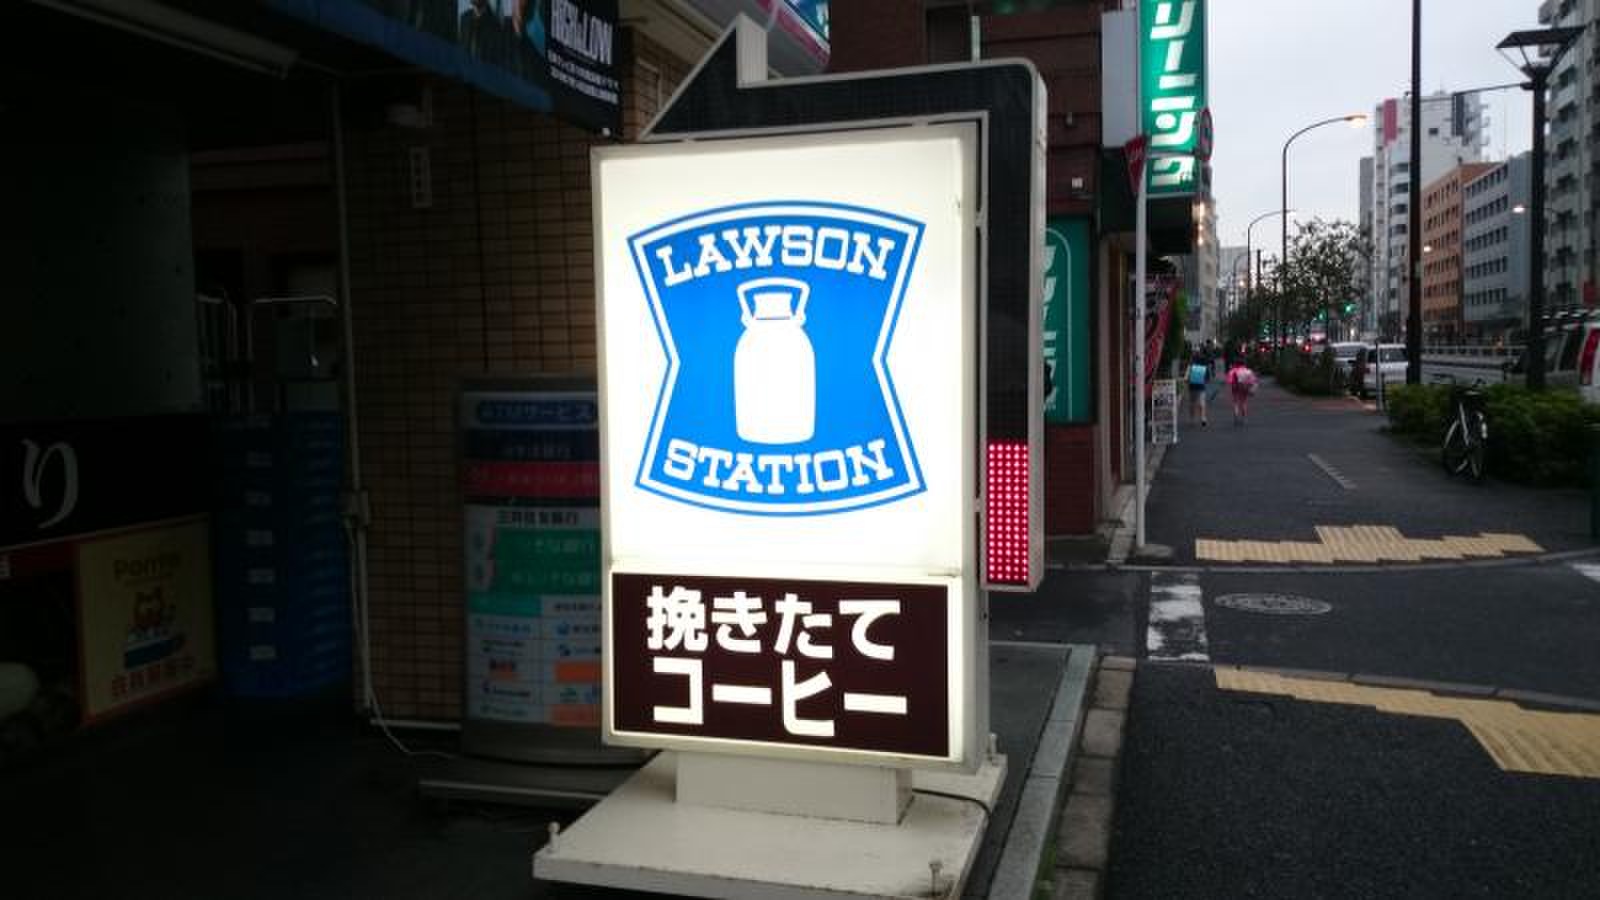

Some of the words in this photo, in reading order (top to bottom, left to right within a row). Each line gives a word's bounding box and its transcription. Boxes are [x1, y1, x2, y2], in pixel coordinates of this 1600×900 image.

[656, 225, 895, 287] LAWSON
[20, 437, 81, 529] り
[663, 438, 894, 494] STATION
[647, 585, 901, 661] 挽きたて
[653, 656, 908, 737] コーヒー
